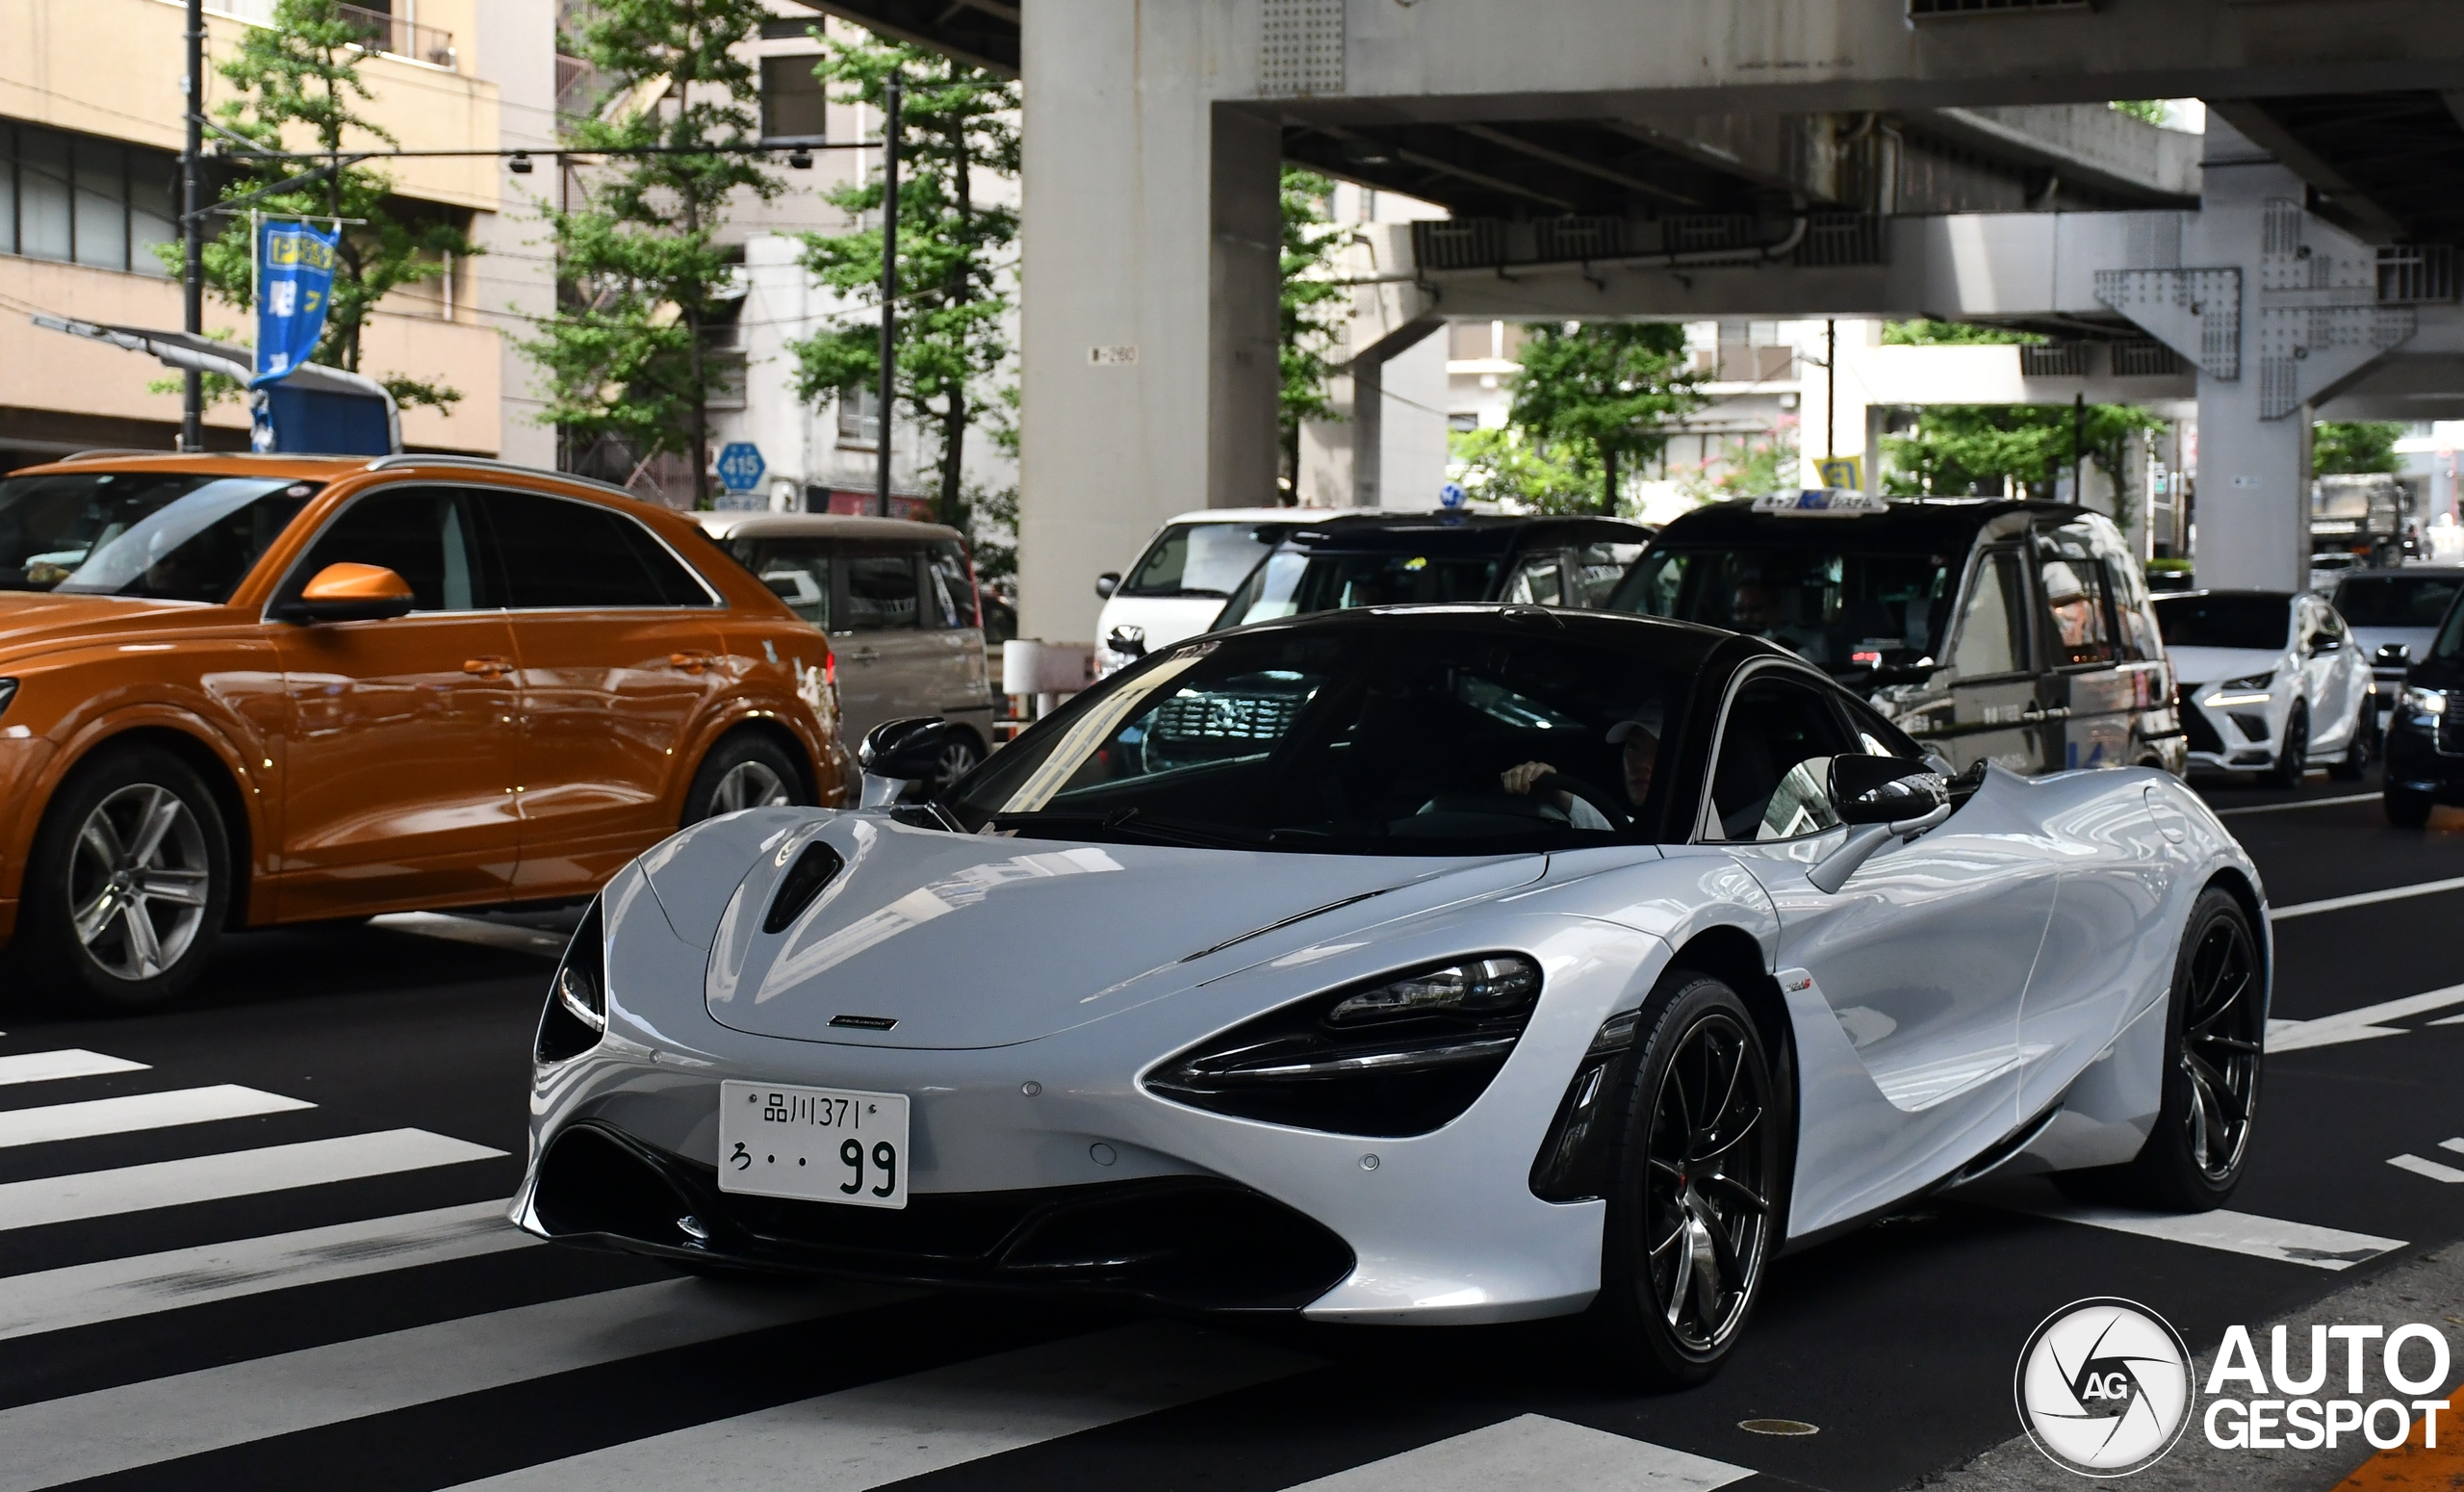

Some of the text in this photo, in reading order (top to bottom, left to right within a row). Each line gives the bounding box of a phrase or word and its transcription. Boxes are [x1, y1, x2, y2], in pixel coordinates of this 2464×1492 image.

[722, 454, 759, 476] 415
[730, 1142, 752, 1170] ろ
[839, 1138, 896, 1197] 99
